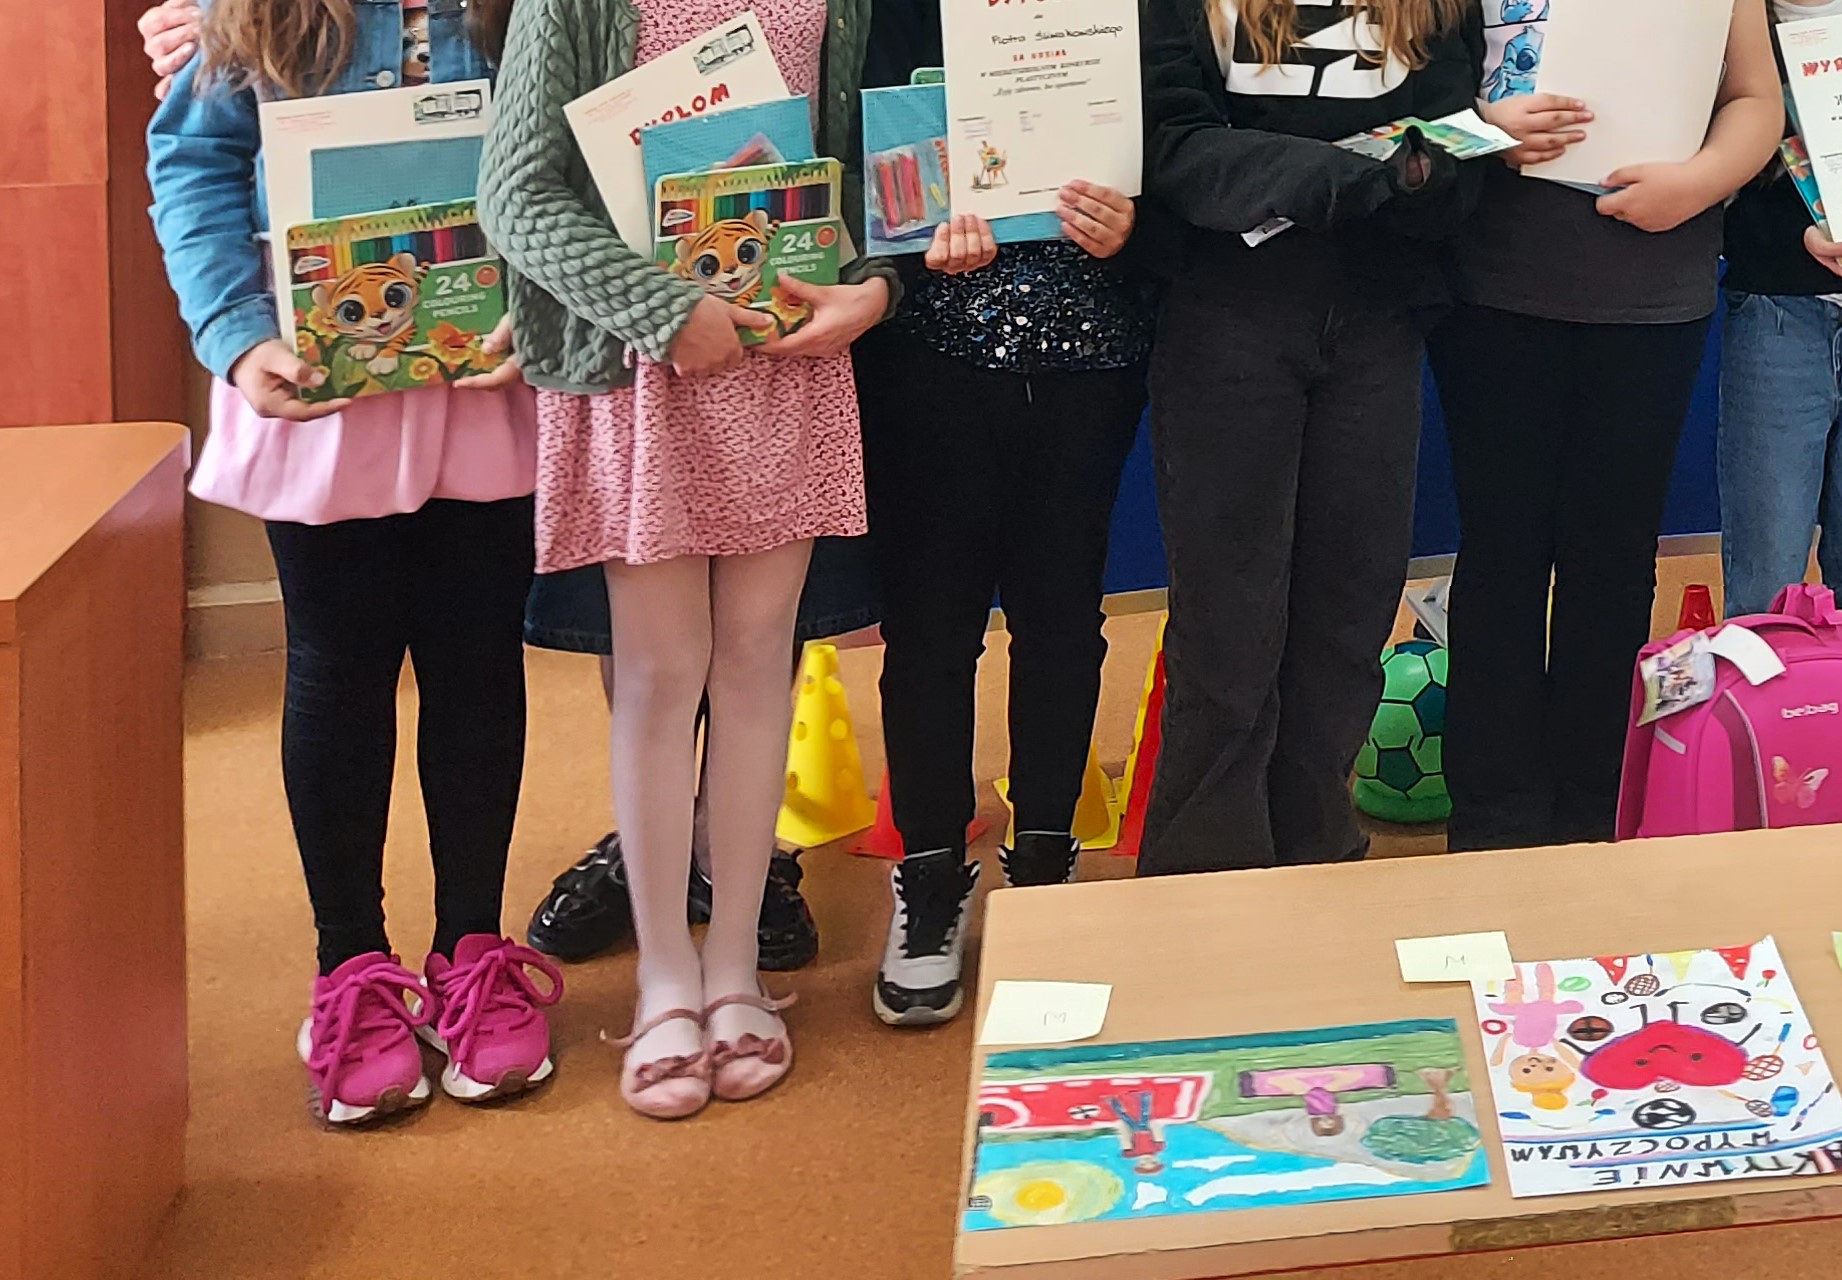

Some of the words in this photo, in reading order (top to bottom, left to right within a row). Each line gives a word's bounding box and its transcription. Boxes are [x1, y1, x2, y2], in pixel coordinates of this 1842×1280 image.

[629, 83, 731, 146] DPLOM
[782, 231, 814, 254] 24
[435, 272, 472, 296] 24
[1510, 1130, 1779, 1163] WYPOCZYWAM
